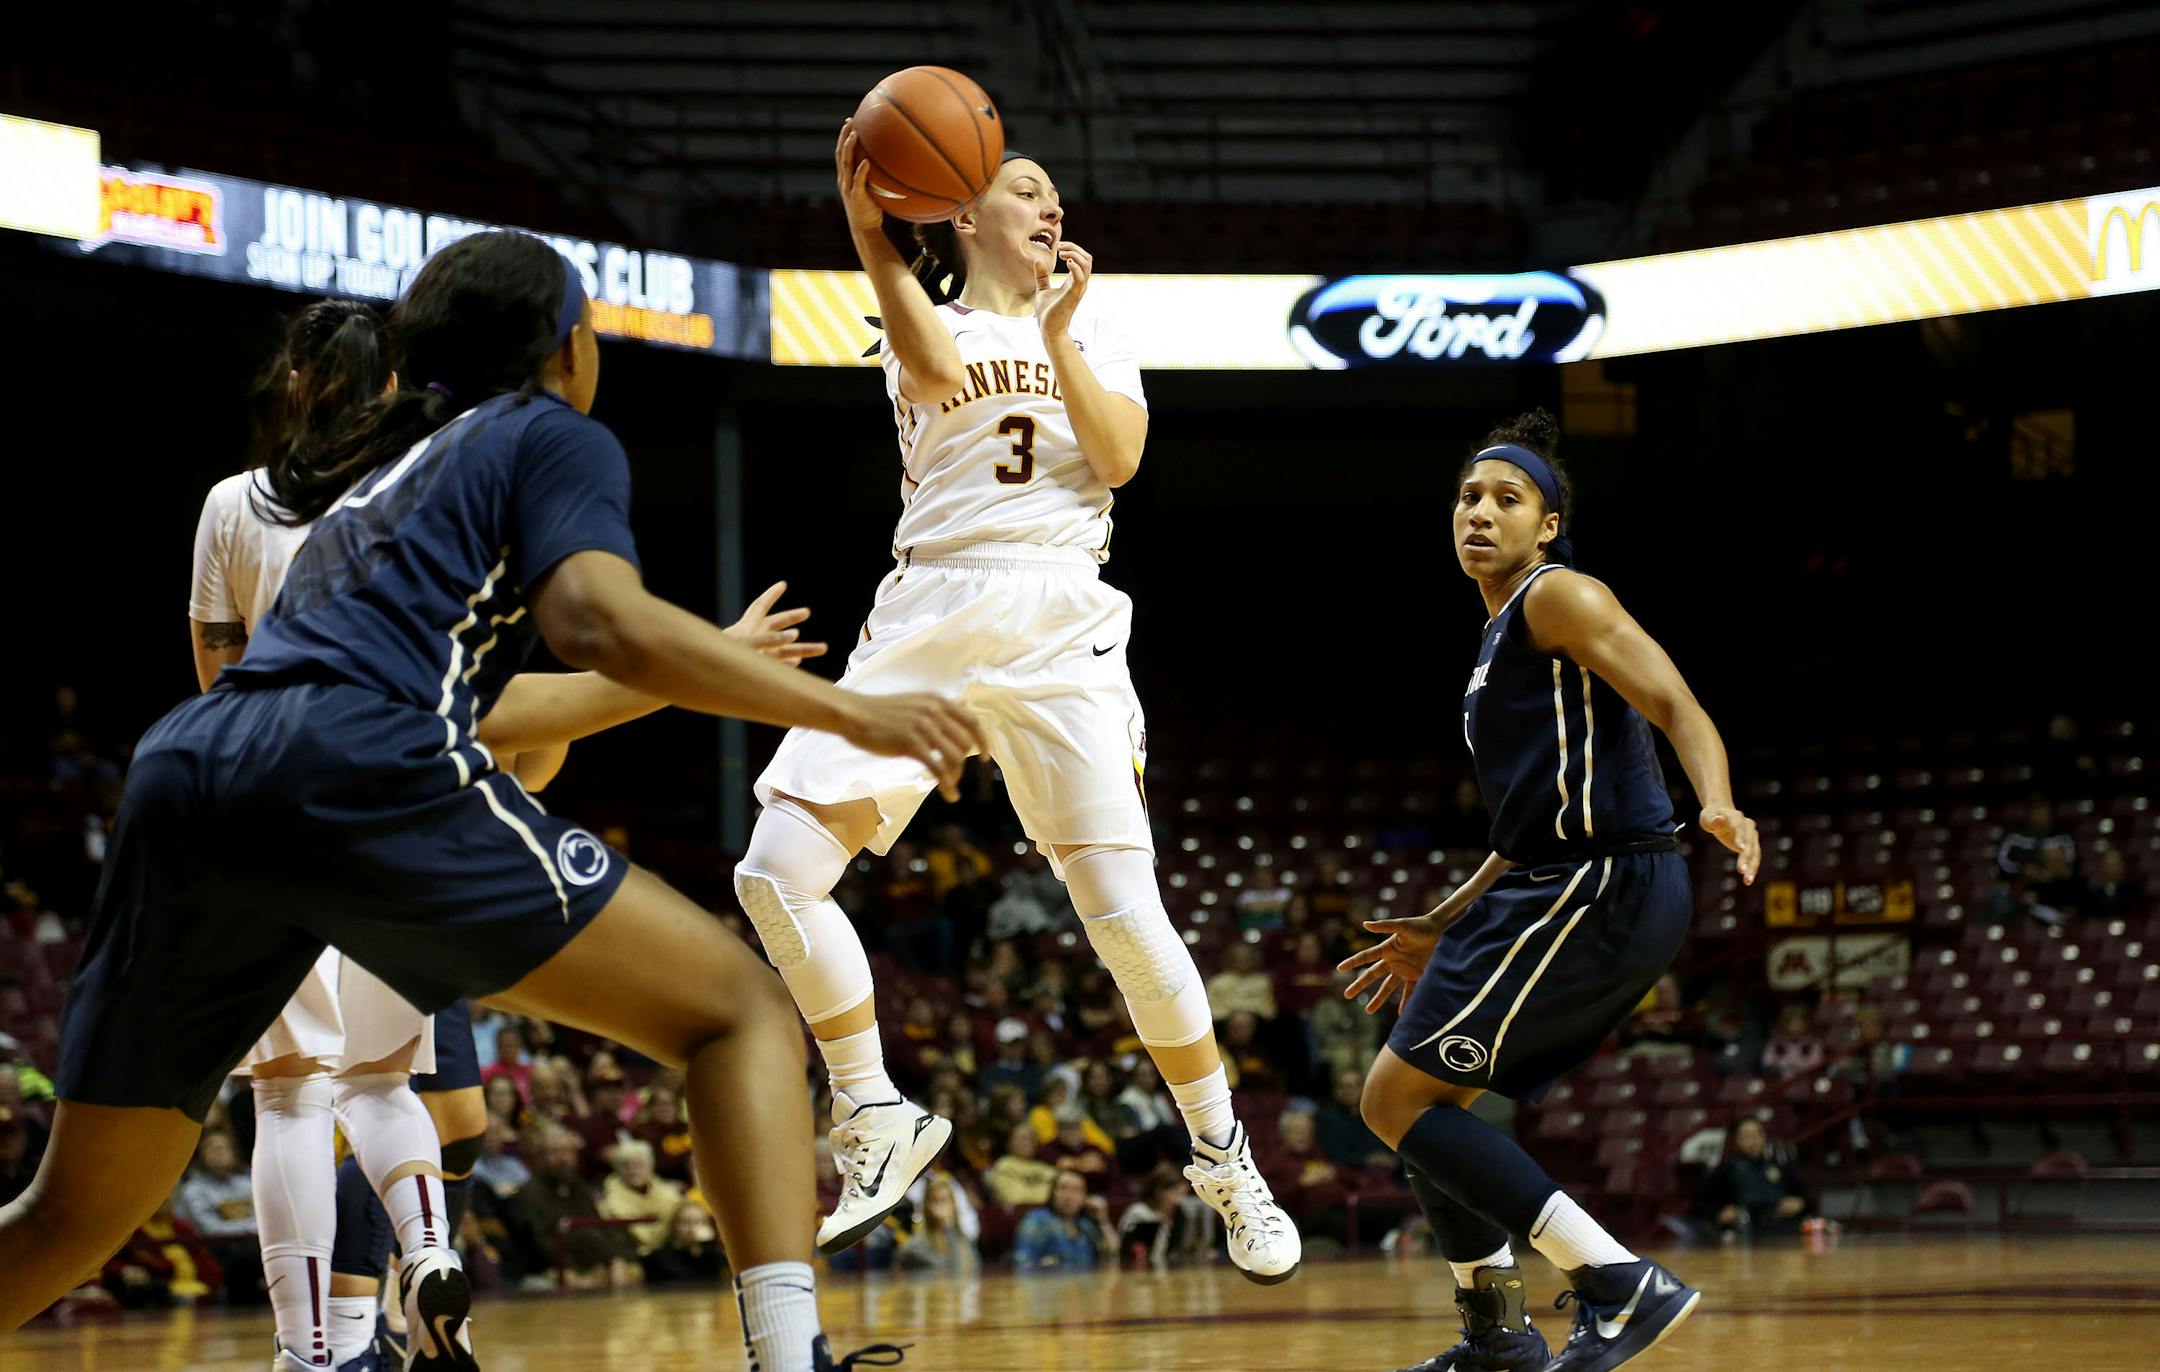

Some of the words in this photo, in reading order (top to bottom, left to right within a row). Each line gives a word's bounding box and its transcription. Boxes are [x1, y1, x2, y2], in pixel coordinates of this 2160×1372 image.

[264, 187, 348, 256] JOIN
[605, 246, 695, 316] CLUB
[1359, 279, 1539, 359] Ford
[993, 413, 1036, 485] 3
